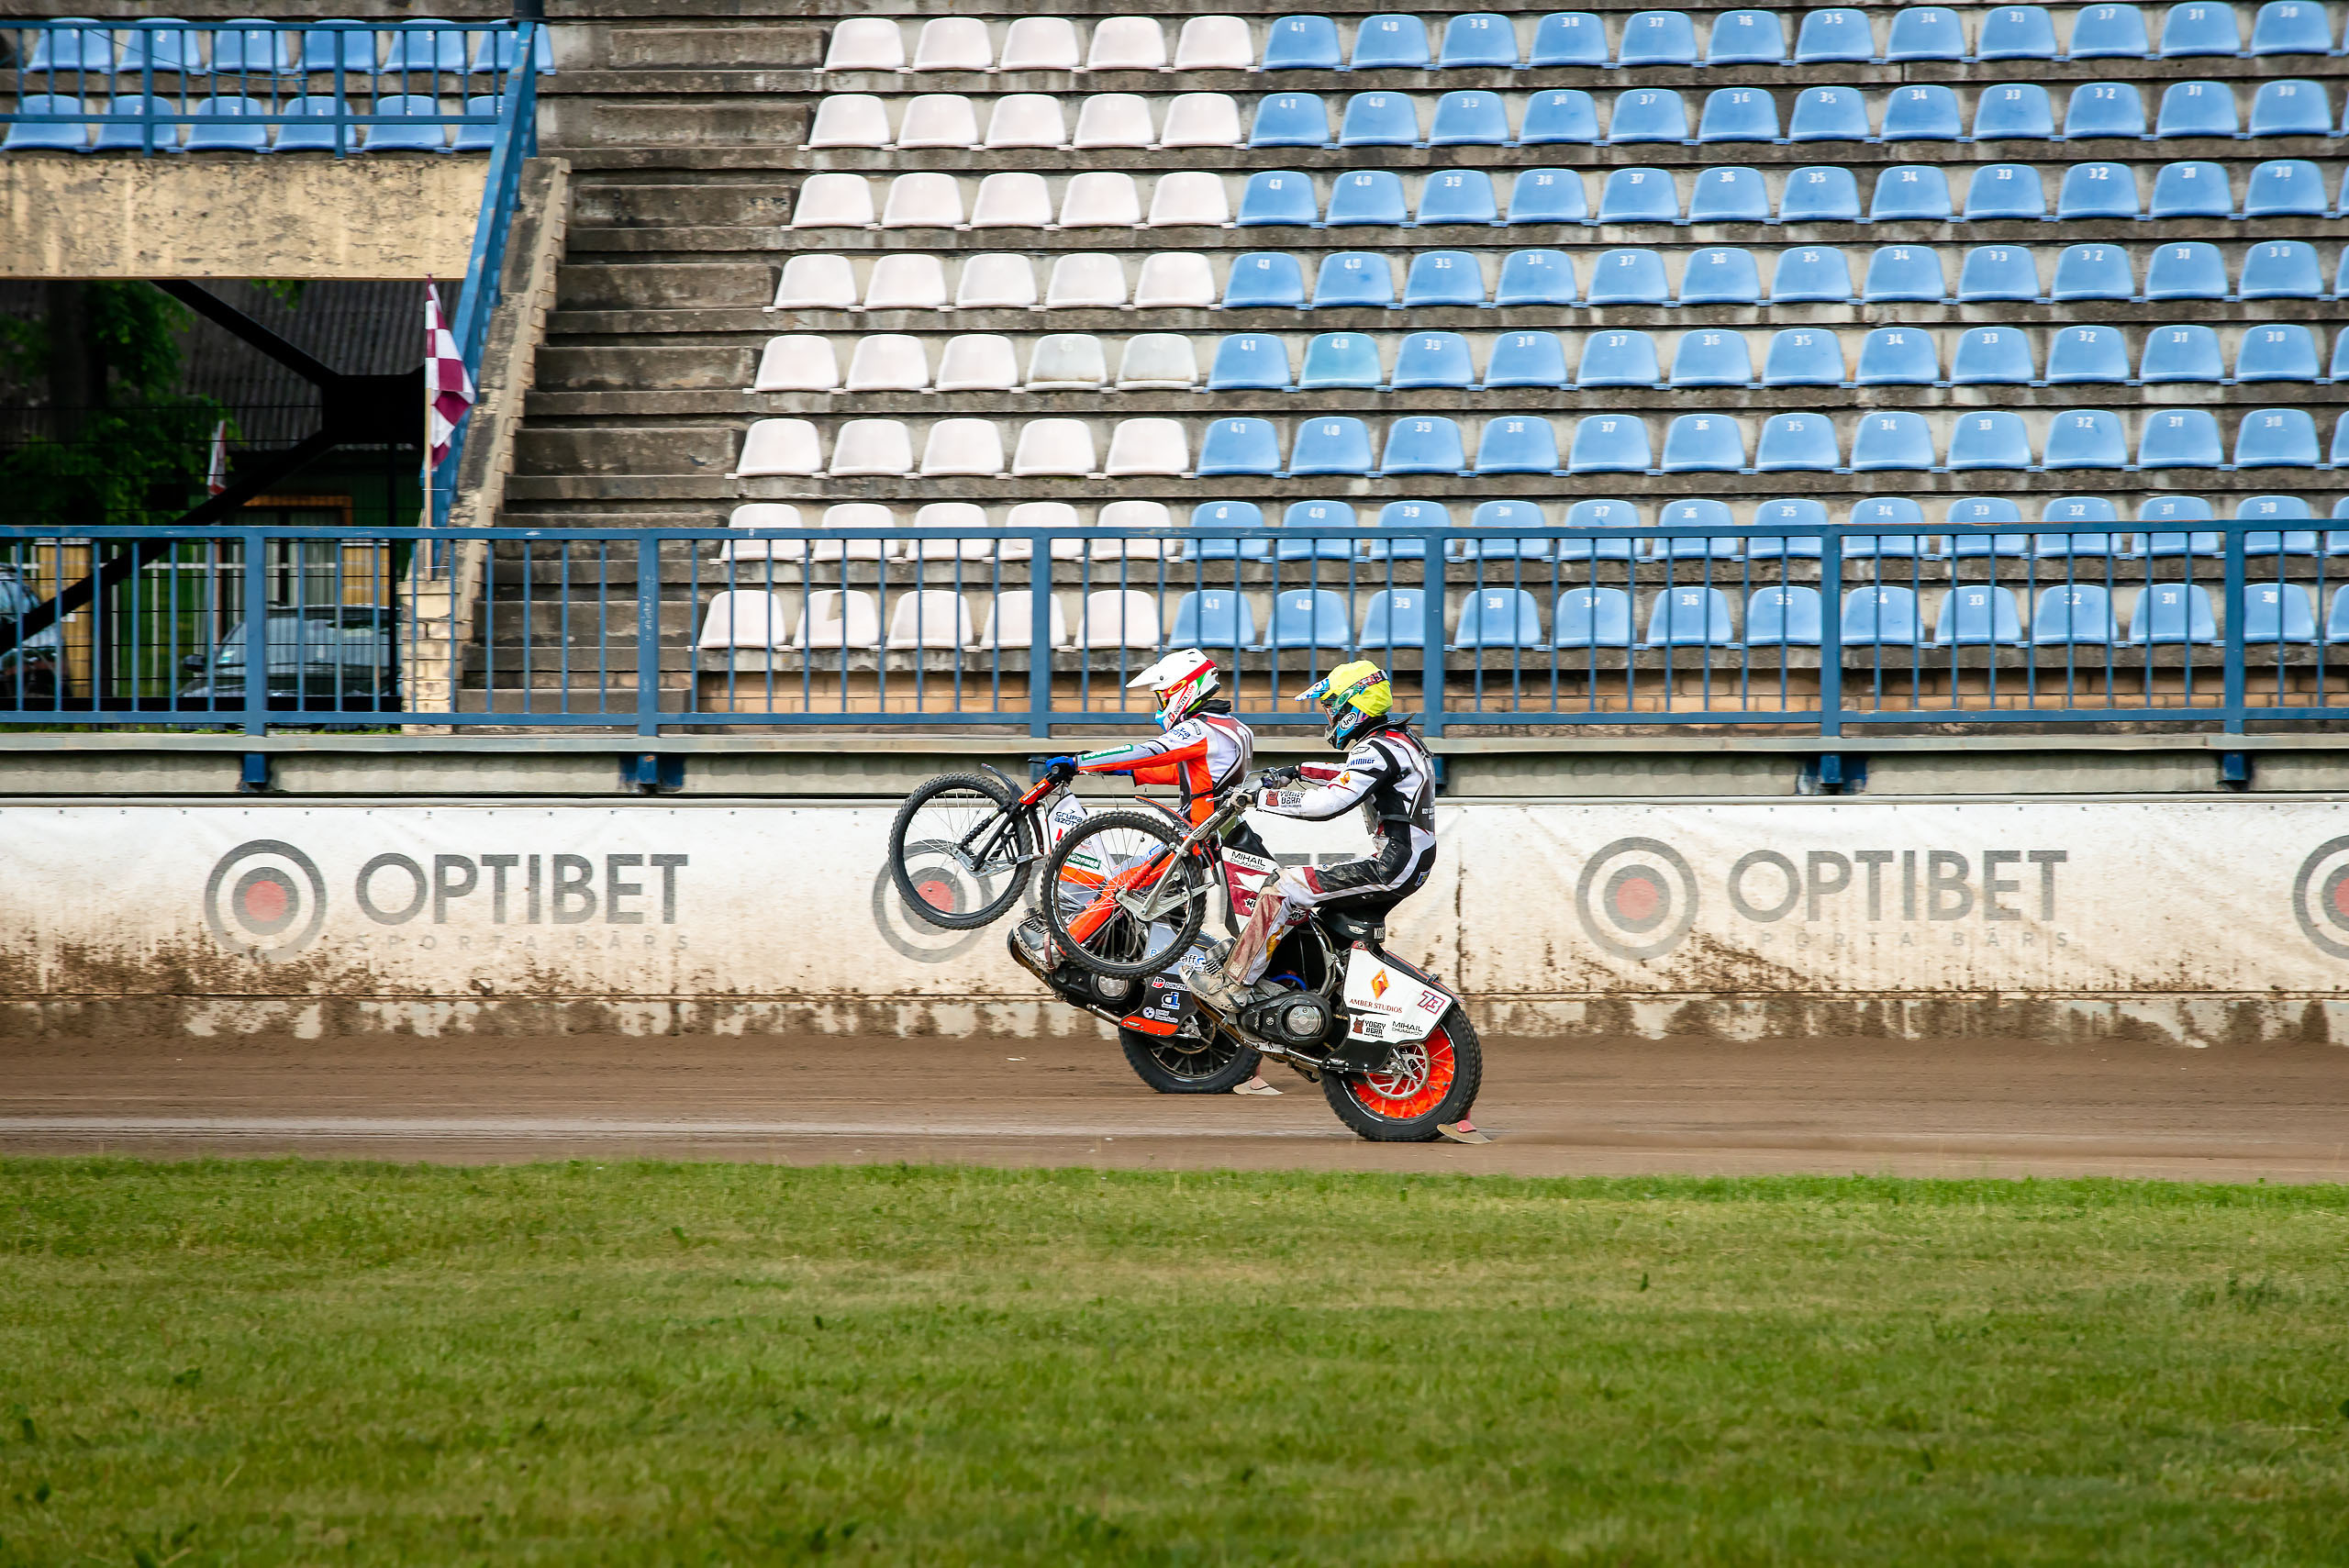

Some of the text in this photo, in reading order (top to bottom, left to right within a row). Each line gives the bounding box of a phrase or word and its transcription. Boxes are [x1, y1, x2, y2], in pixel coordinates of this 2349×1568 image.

[1231, 851, 1266, 867] MIHAIL
[355, 851, 689, 926] OPTIBET
[1728, 850, 2069, 923] OPTIBET
[354, 934, 543, 951] SPORTA
[1728, 927, 2069, 949] SPORTA BĀRS
[1349, 998, 1403, 1014] AMBER STUDIOS
[1418, 990, 1446, 1015] 73
[1364, 1019, 1386, 1029] YOGGY
[1392, 1020, 1423, 1032] MIHAIL
